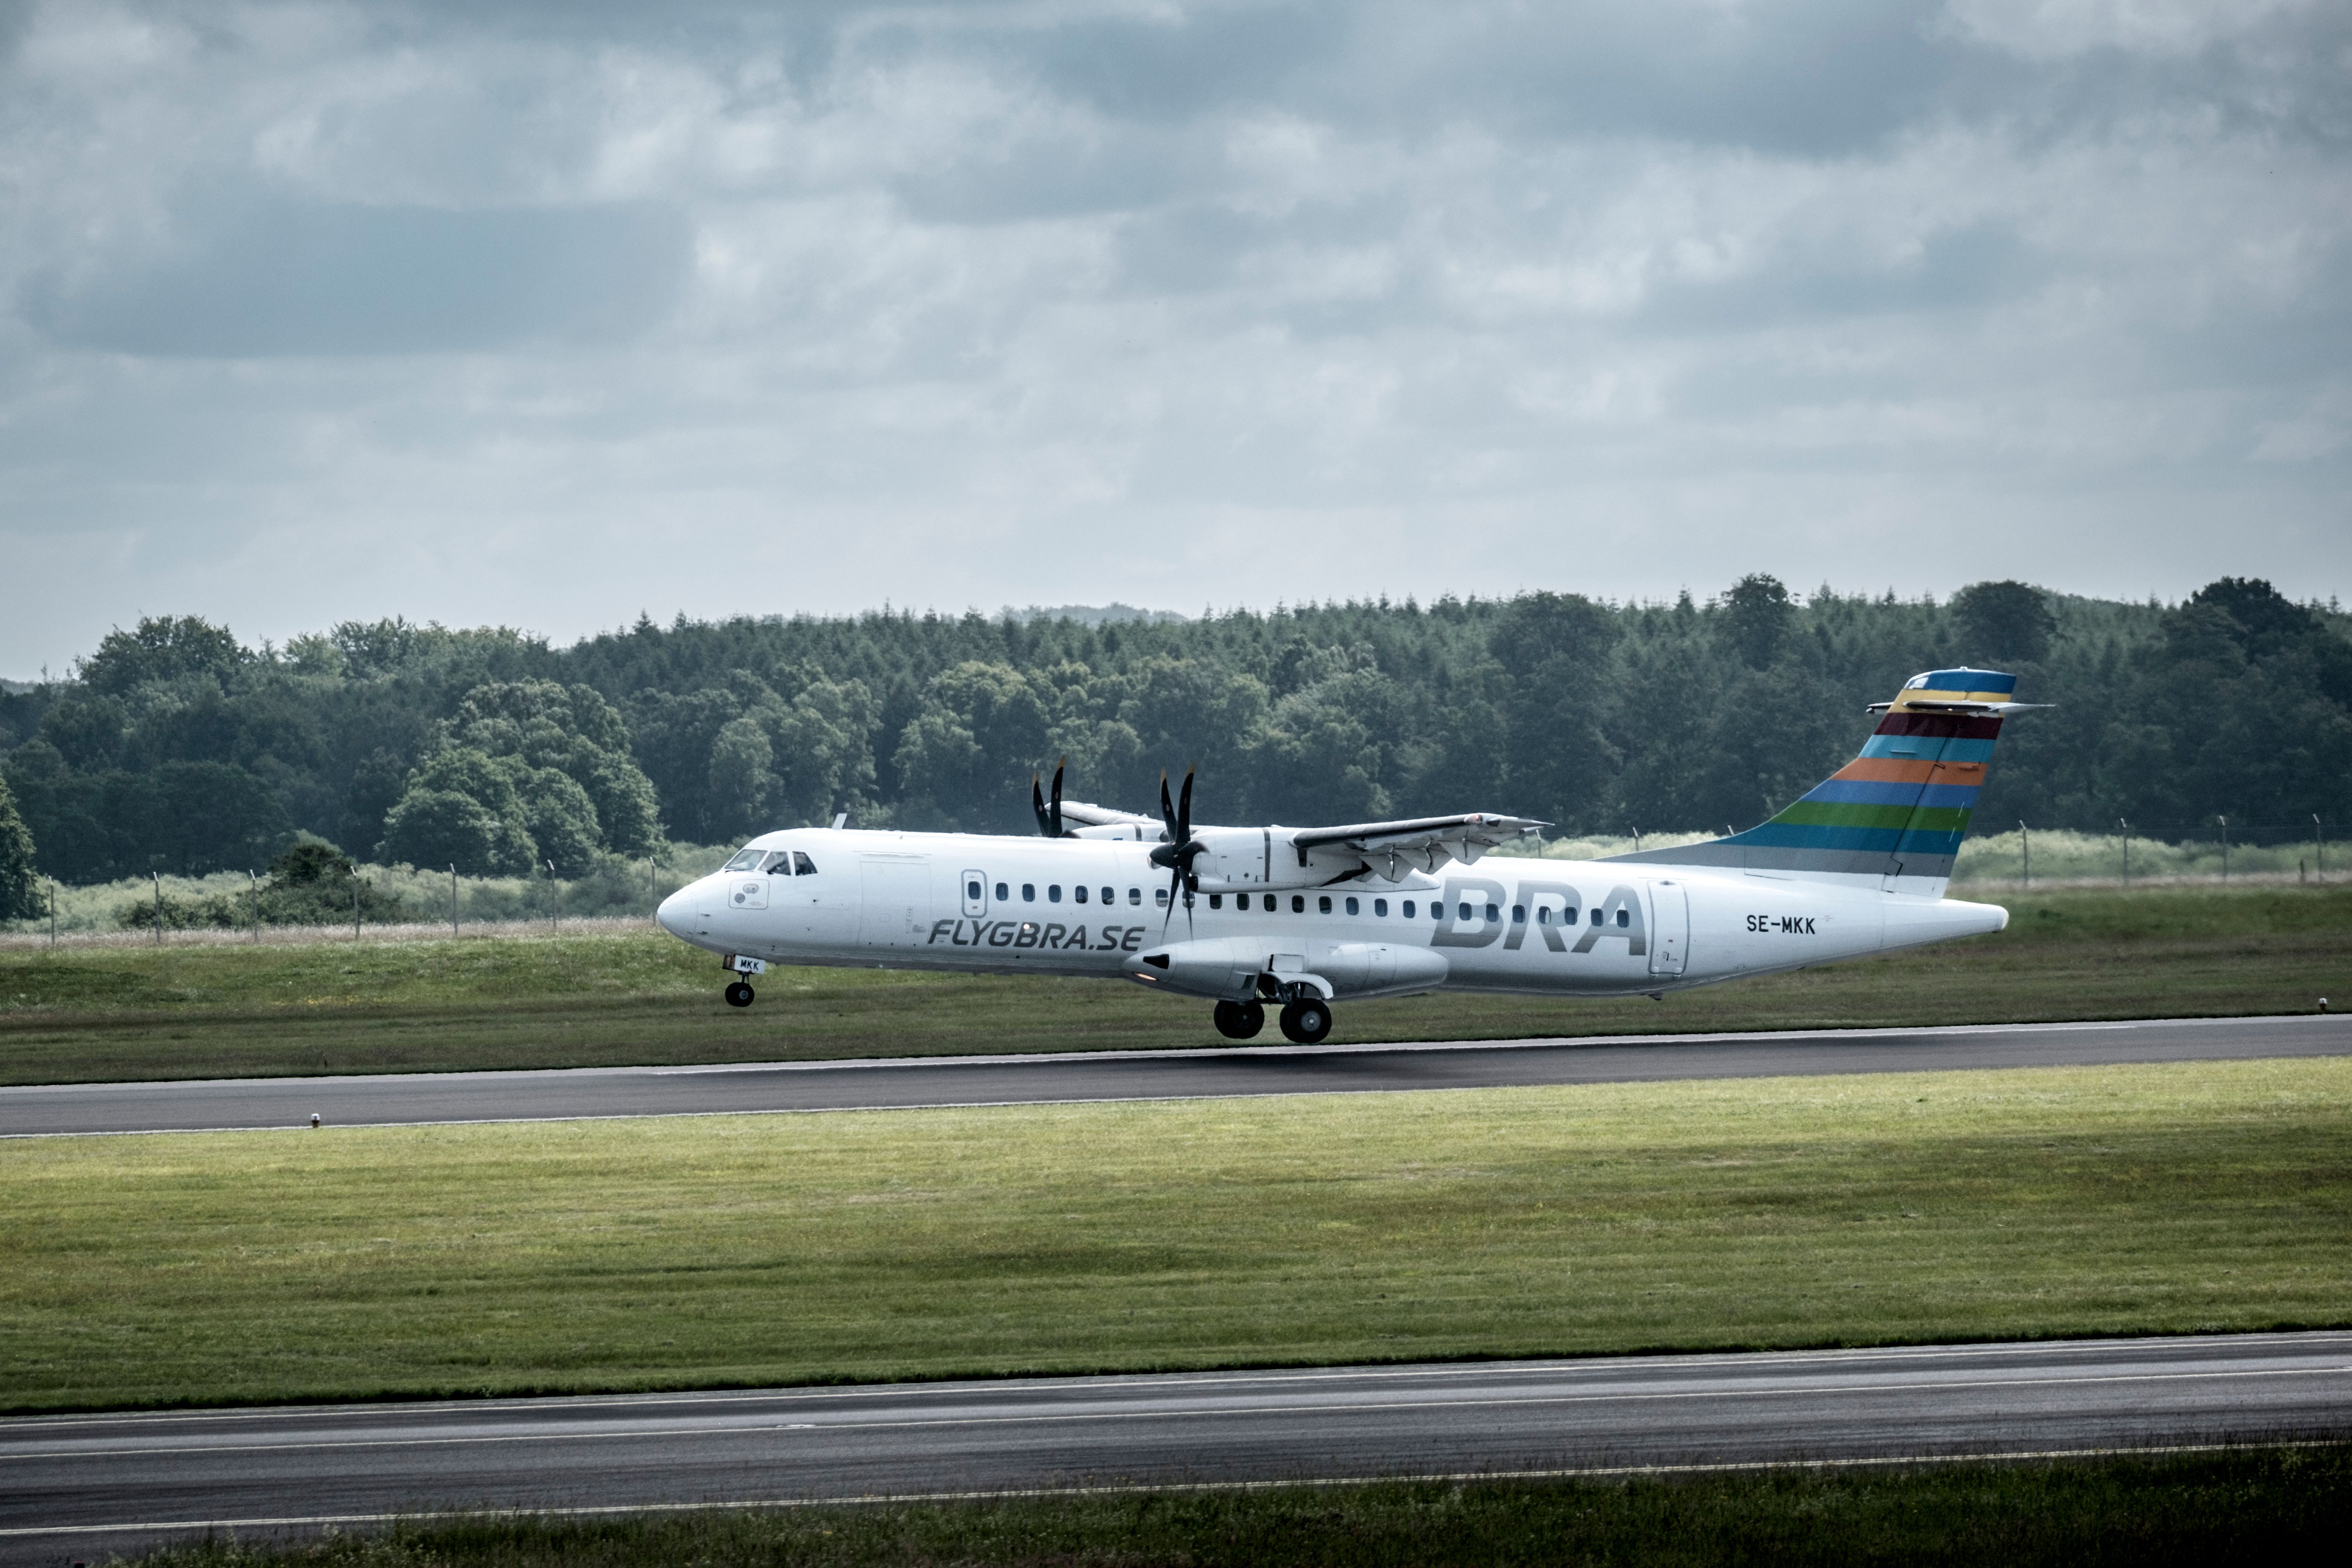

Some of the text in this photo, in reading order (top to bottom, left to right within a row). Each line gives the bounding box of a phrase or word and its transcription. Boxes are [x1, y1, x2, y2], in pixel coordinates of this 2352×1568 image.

[1430, 876, 1646, 956] BRA
[1747, 914, 1815, 934] SE-MKK
[927, 919, 1146, 951] FLYGBRA.SE
[740, 959, 759, 971] MKK
